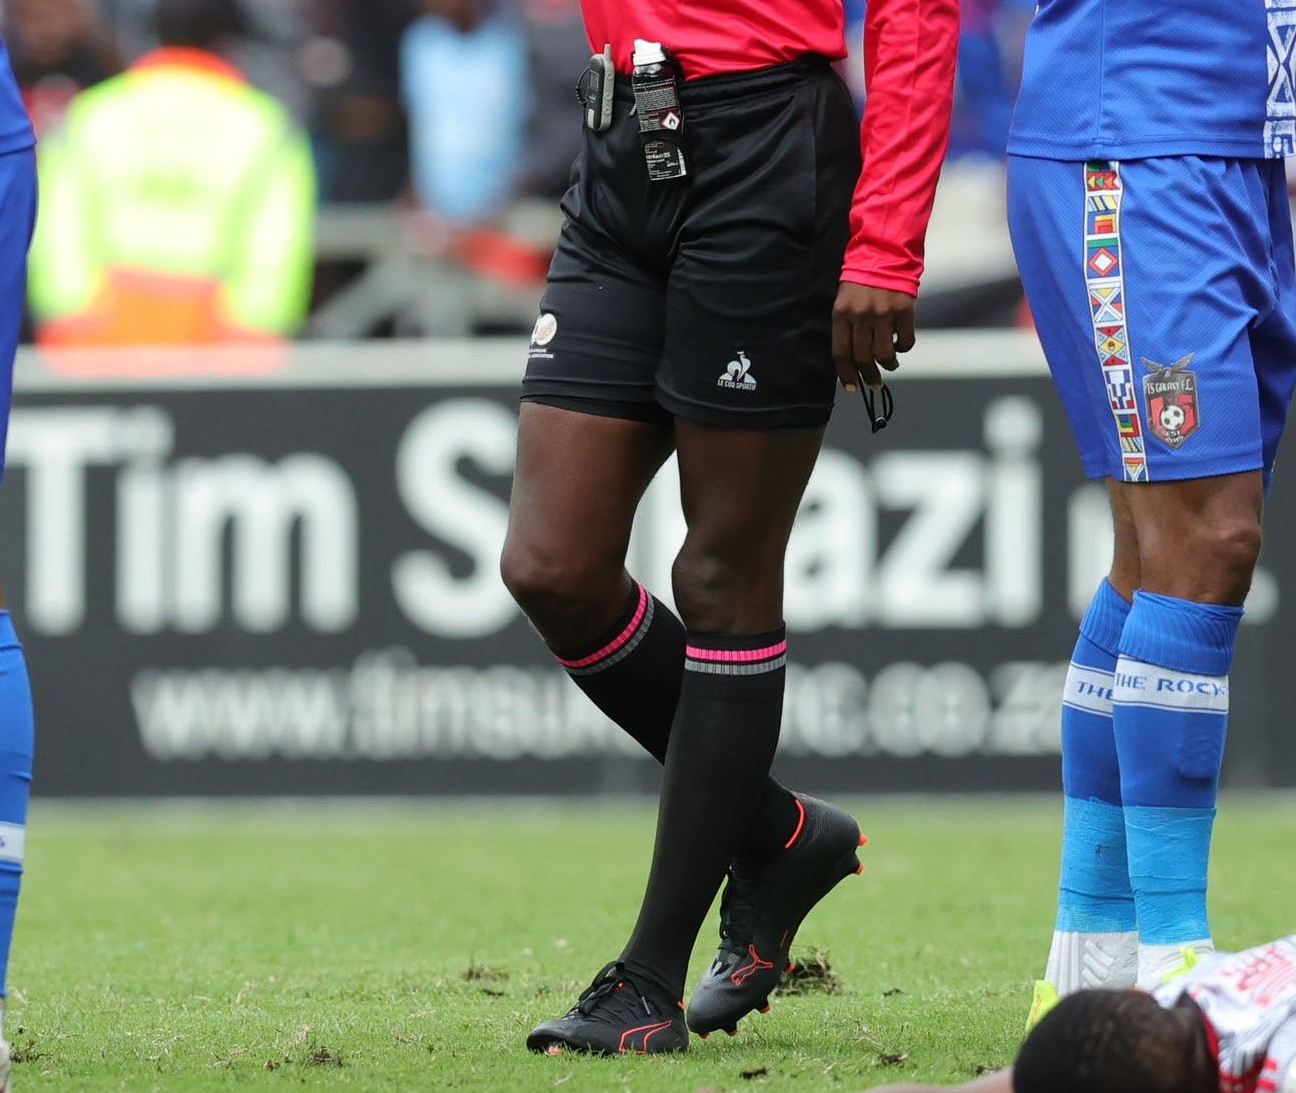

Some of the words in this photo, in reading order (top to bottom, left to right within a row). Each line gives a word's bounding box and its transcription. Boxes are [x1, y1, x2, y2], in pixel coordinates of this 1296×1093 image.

[7, 404, 360, 637] Tim
[390, 394, 1043, 640] Sazi
[1116, 672, 1146, 692] THE
